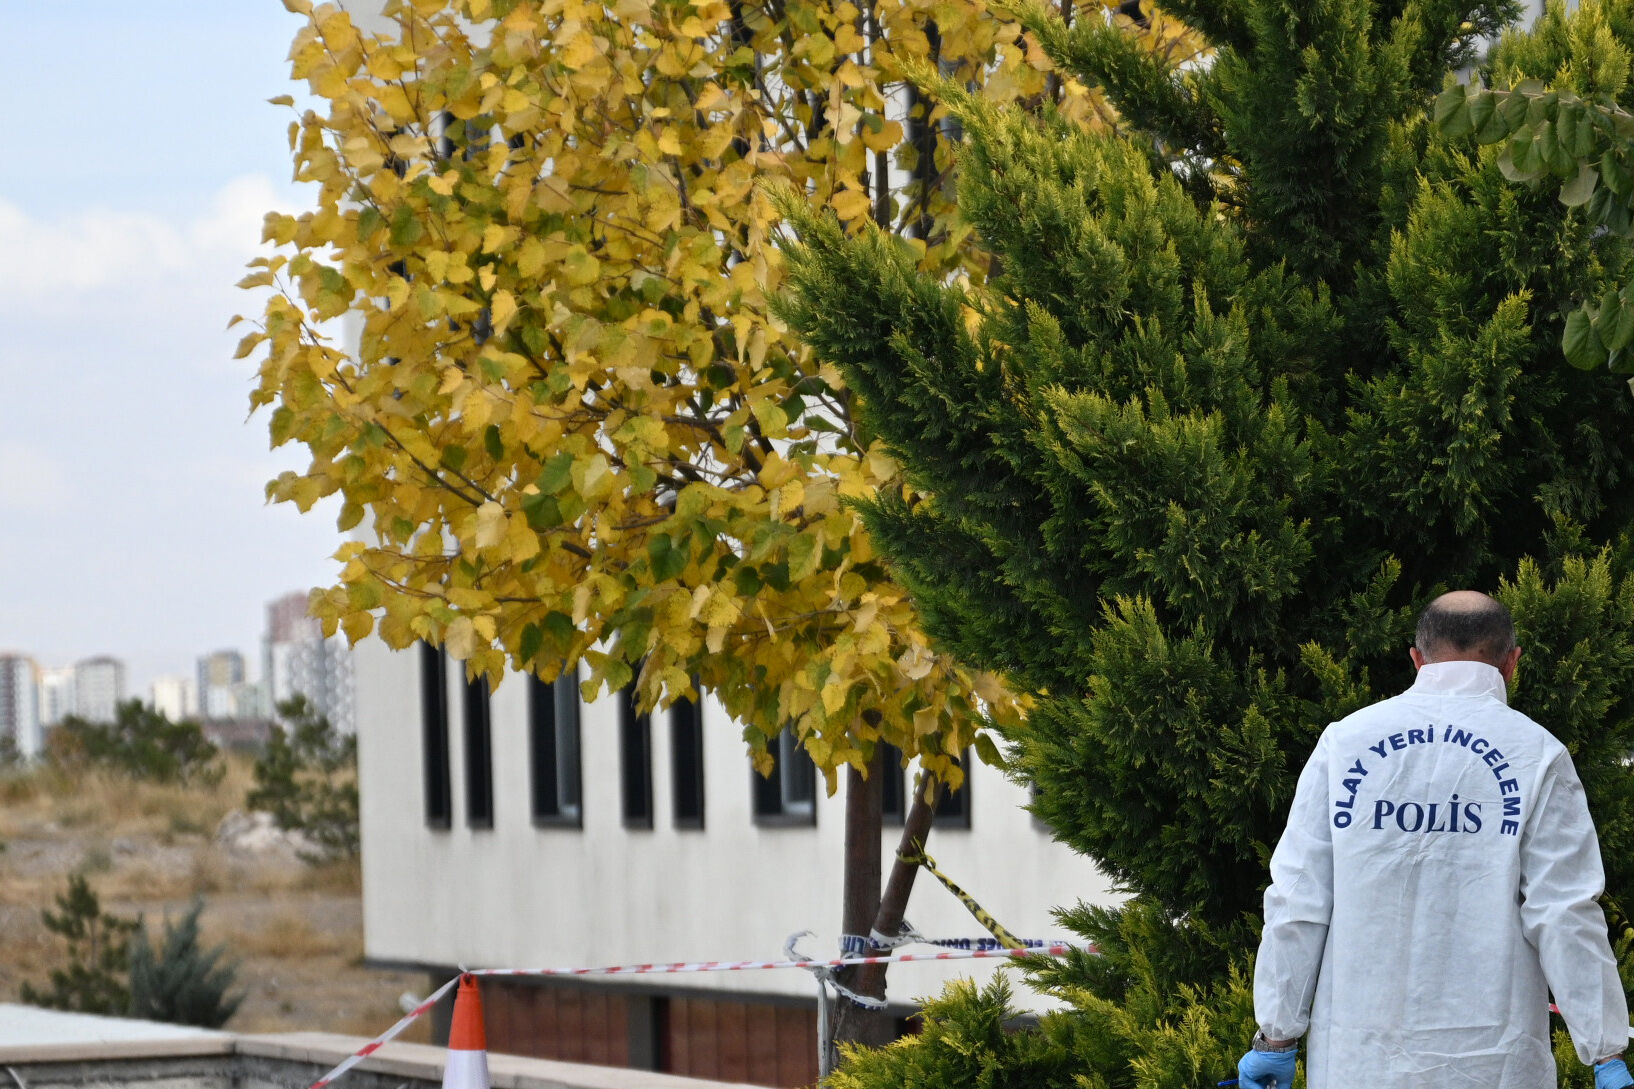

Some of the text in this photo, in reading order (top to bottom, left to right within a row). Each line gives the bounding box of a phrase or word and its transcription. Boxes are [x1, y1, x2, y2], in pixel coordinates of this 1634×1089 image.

[1334, 724, 1521, 837] OLAY YERİ İNCELEME
[1372, 794, 1482, 834] POLİS
